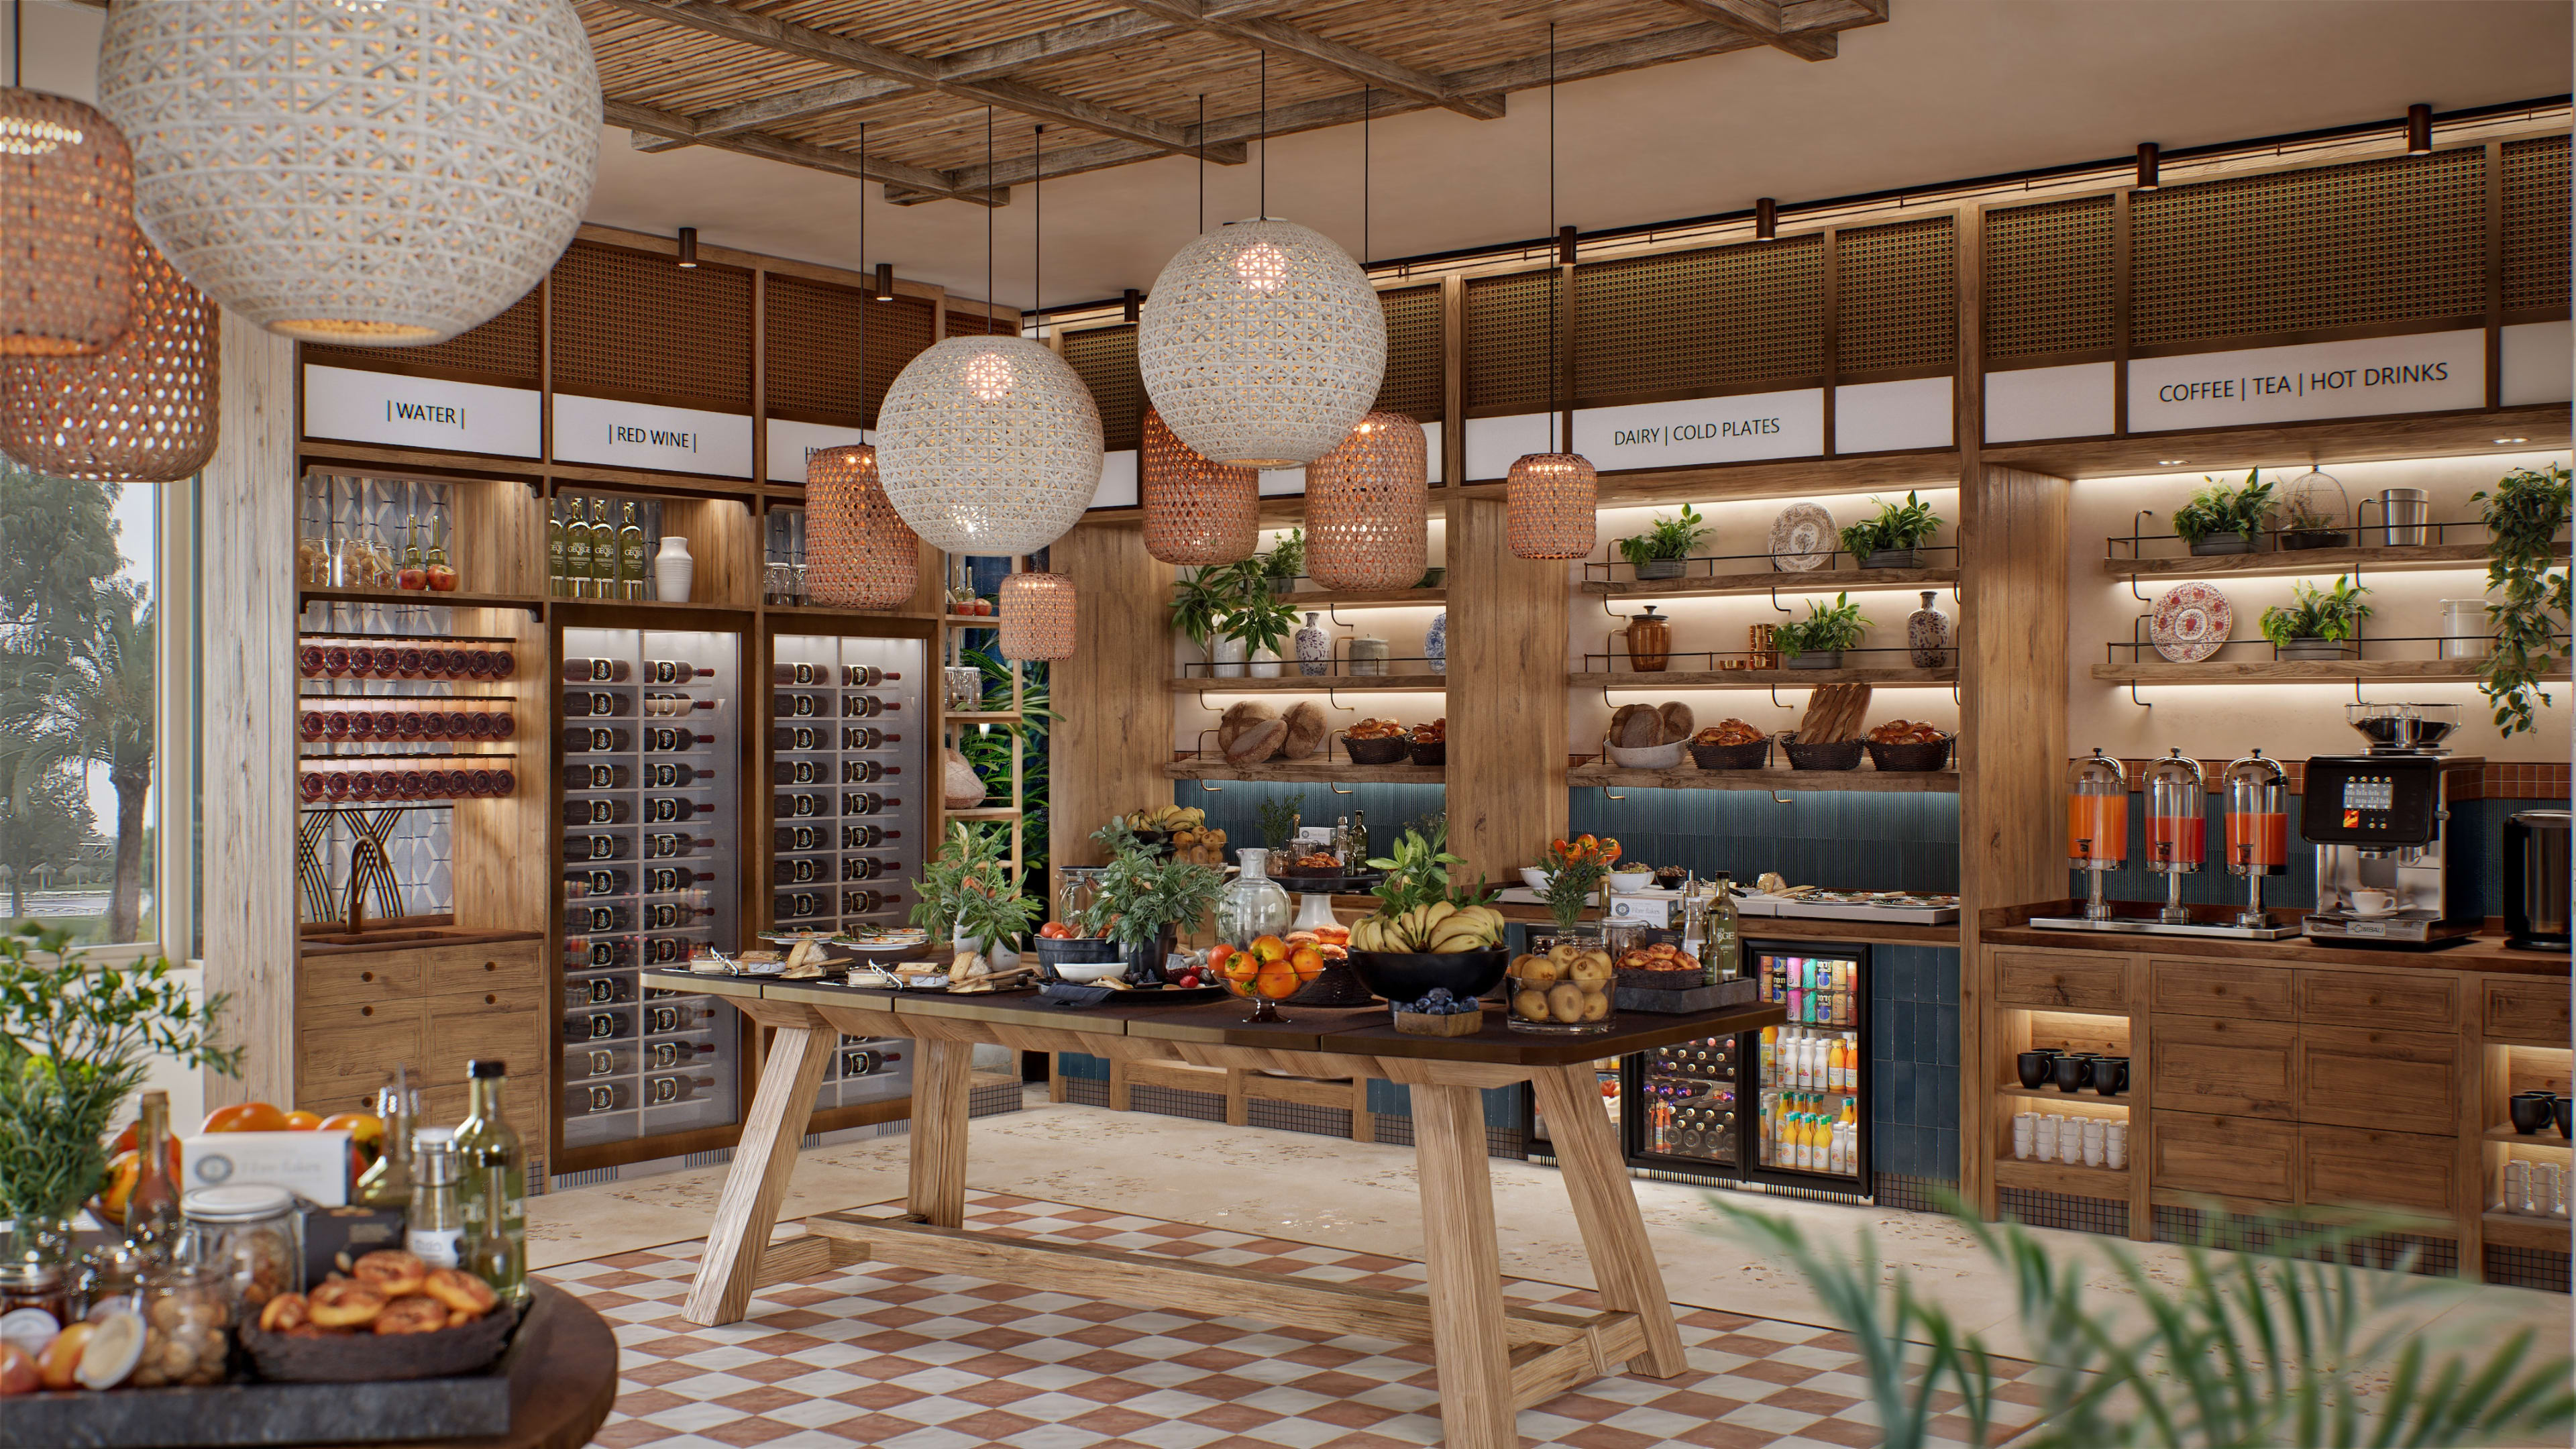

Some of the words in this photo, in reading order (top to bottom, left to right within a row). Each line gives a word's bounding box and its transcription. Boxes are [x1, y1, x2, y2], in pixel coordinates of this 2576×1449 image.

[2159, 380, 2235, 402] COFFEE
[2252, 376, 2292, 395] TEA
[2311, 370, 2357, 390] HOT
[2365, 362, 2449, 386] DRINKS
[396, 402, 456, 424] WATER
[617, 426, 646, 443] RED
[649, 429, 690, 448] WINE
[1615, 427, 1660, 446] DAIRY
[1673, 423, 1717, 441] COLD
[1722, 417, 1780, 437] PLATES
